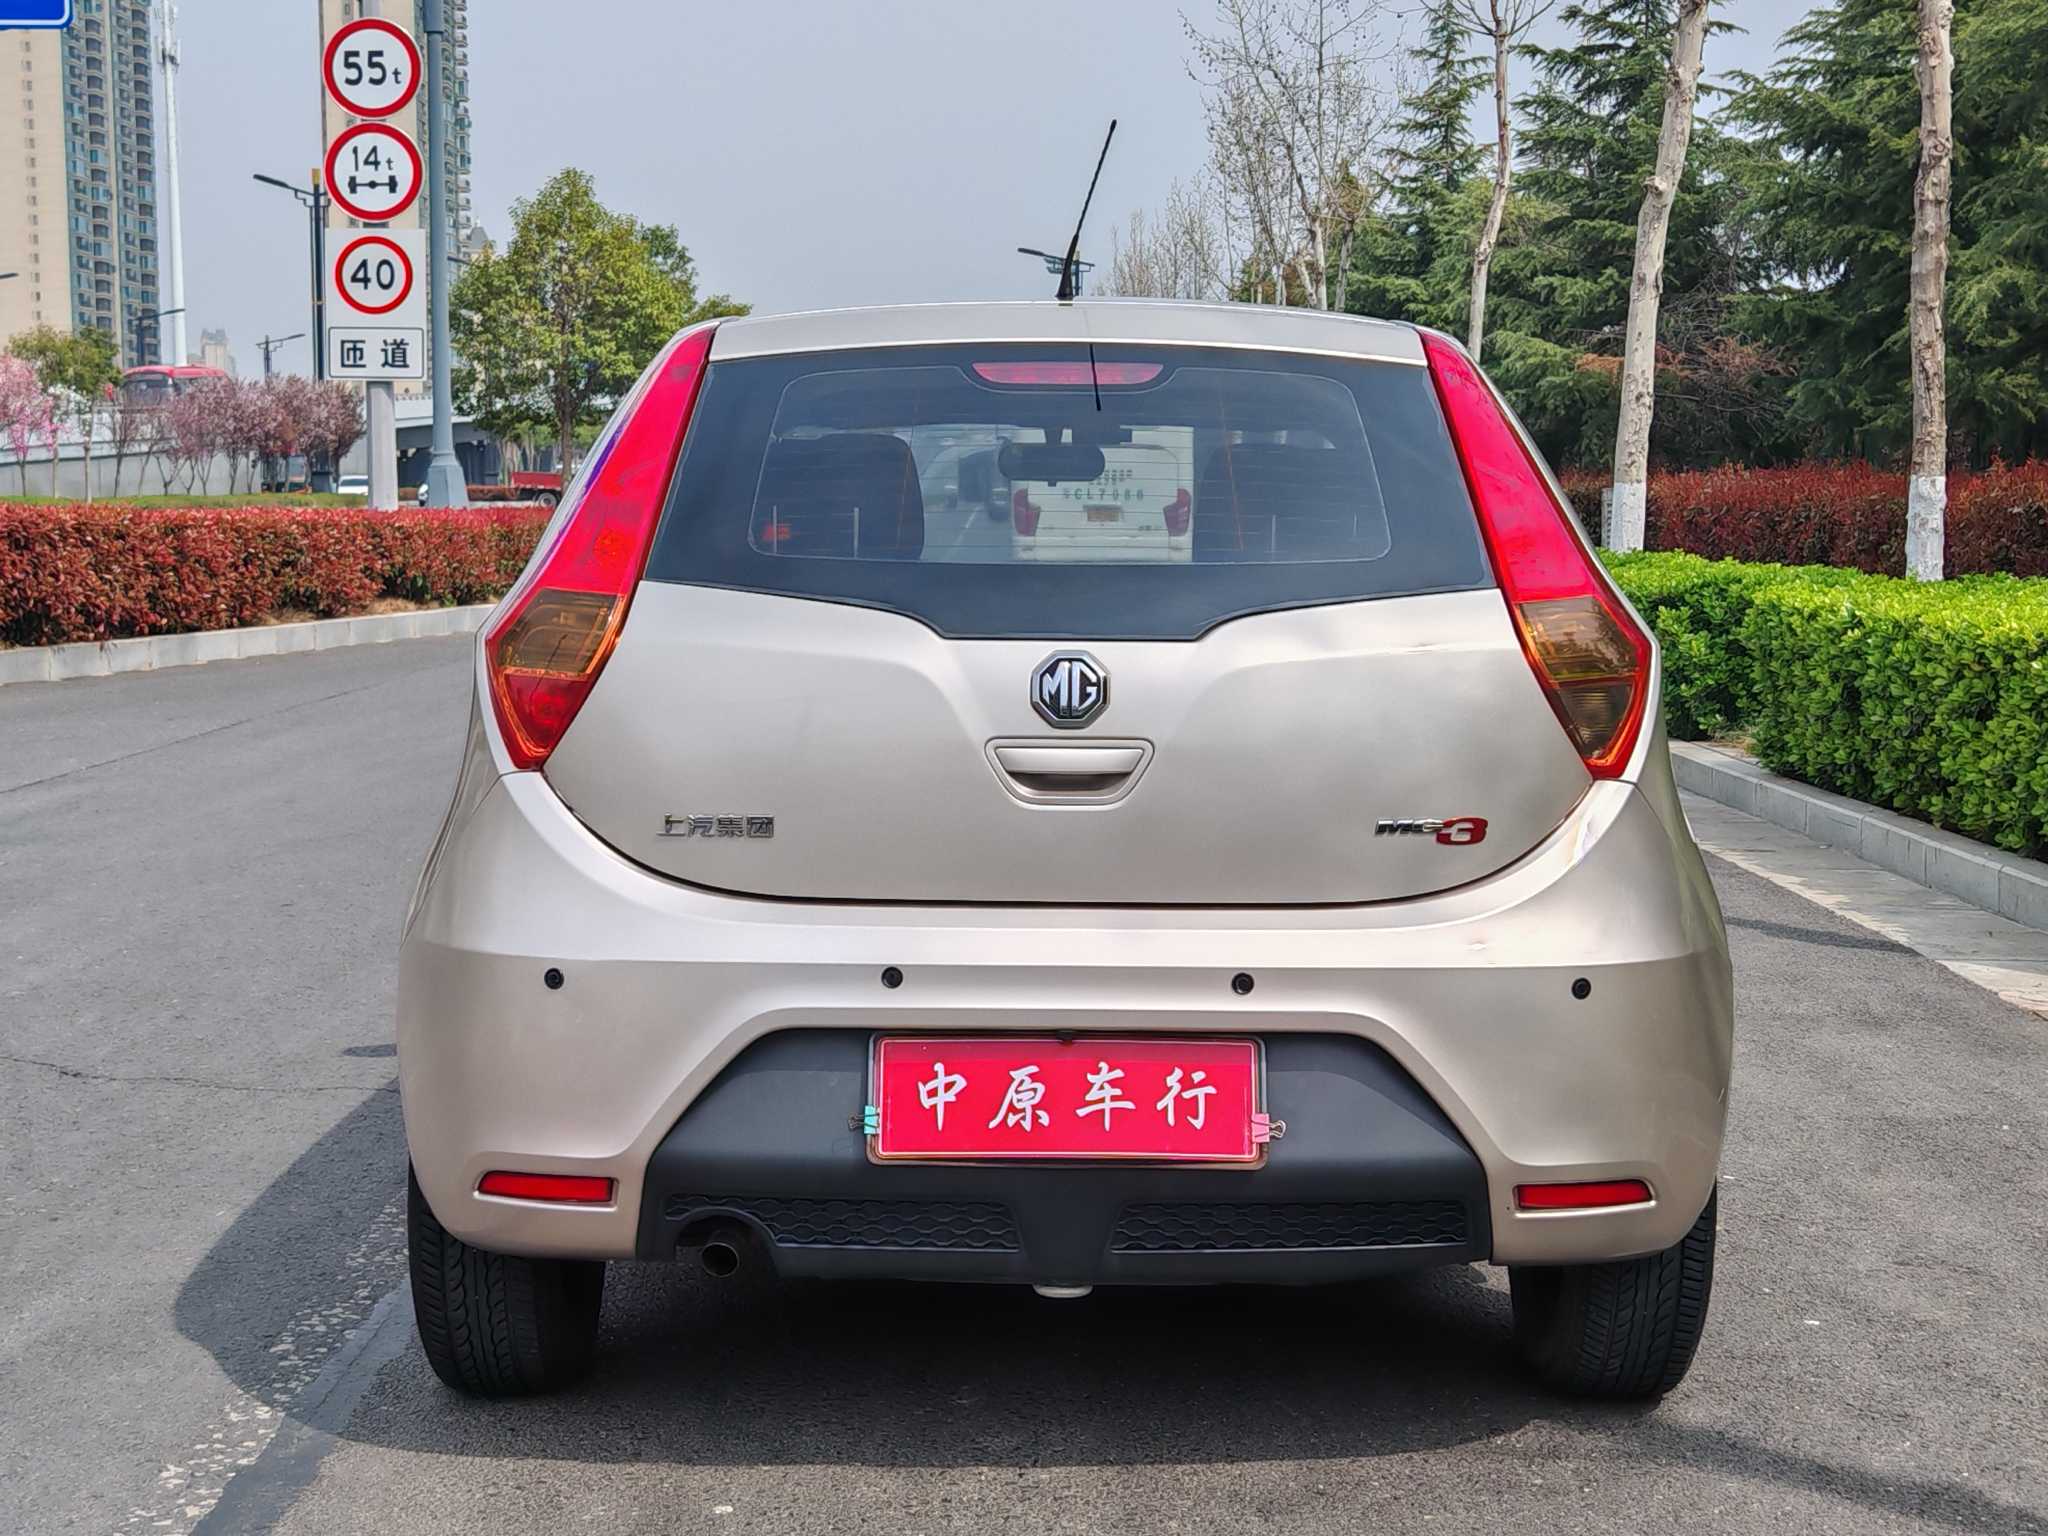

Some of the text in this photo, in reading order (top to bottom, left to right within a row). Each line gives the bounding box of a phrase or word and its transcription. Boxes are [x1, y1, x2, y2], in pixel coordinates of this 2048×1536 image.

[343, 50, 402, 86] 55t
[352, 145, 394, 172] 14t
[350, 258, 395, 291] 40
[340, 338, 411, 369] 匝道
[1039, 658, 1101, 719] MG
[656, 813, 776, 839] 上汽集团
[1375, 816, 1489, 846] MG3
[917, 1061, 1218, 1132] 中原车行
